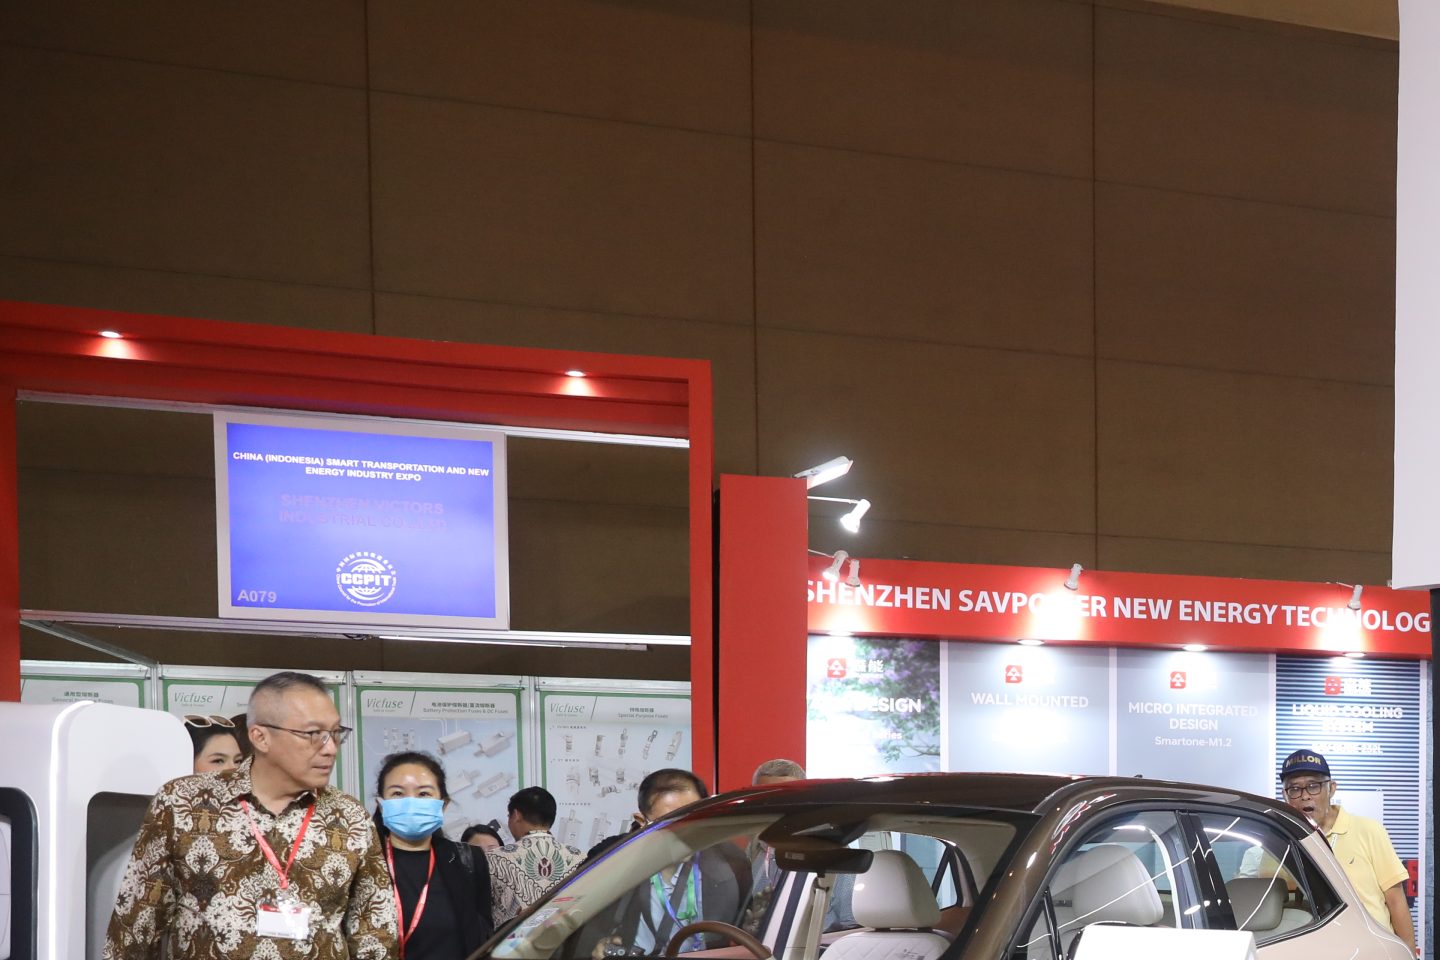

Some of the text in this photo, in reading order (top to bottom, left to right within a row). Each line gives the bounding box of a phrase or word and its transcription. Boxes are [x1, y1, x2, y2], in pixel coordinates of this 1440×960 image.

[232, 452, 490, 477] CHINA (INDONESIA) SMART TRANSPORTATION AND NEW
[305, 466, 422, 482] ENERGY INDUSTRY EXPO
[341, 572, 392, 587] CCPIT
[237, 588, 277, 603] A079
[806, 580, 950, 611] SHENZHEN
[958, 589, 1107, 618] SAVPOER
[1113, 597, 1172, 620] NEW
[1179, 600, 1277, 625] ENERGY
[174, 691, 214, 704] Vicfuse
[366, 697, 404, 709] Vicfuse
[970, 692, 1089, 708] WALL MOUNTED
[550, 702, 586, 714] Vicfuse
[1128, 701, 1258, 717] MICRO INTEGRATED
[1169, 718, 1219, 731] DESIGN
[1155, 735, 1232, 747] Smartone-M1.2
[1285, 755, 1322, 768] MILLOR
